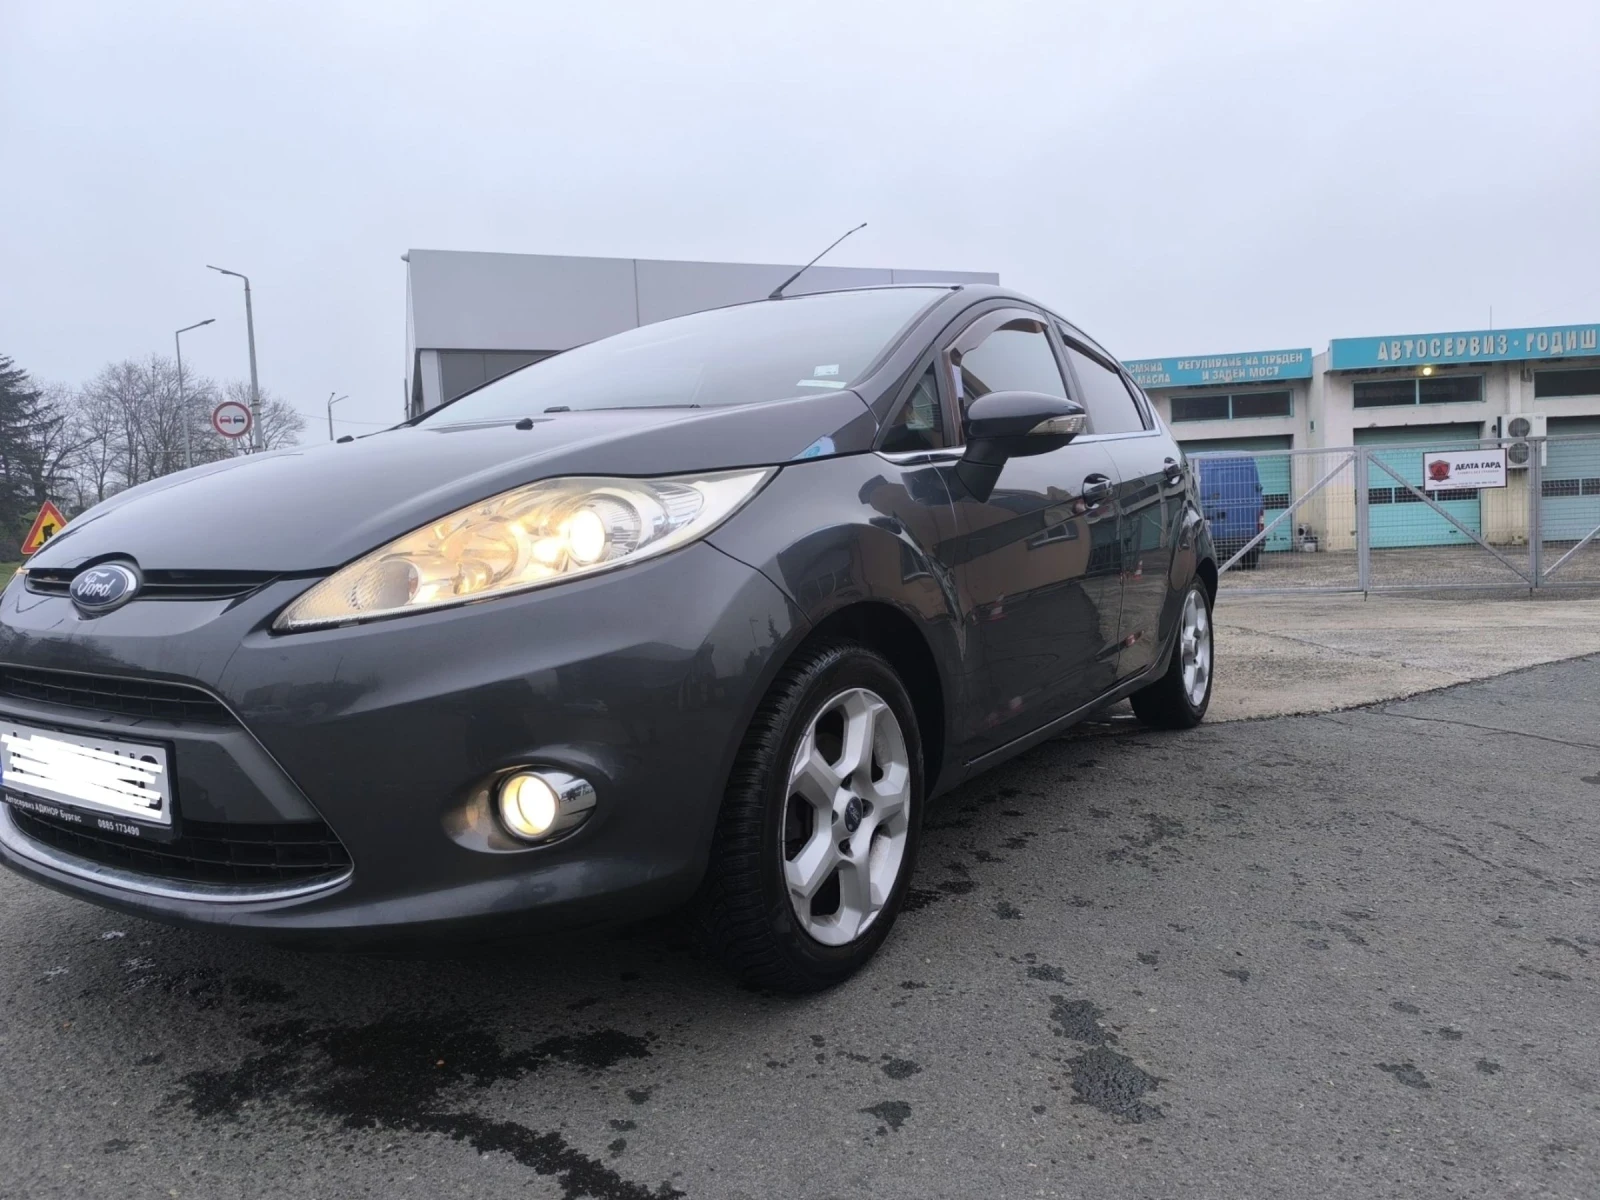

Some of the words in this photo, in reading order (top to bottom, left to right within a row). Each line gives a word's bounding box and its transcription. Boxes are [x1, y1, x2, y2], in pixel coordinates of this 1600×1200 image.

[1377, 334, 1508, 361] АВТОСЕРВИЗ
[1526, 329, 1597, 355] ГОДИШ
[1129, 362, 1163, 373] СМЯНА
[1177, 356, 1242, 370] РЕГУЛИРАНЕ
[1245, 356, 1258, 366] НА
[1262, 353, 1303, 365] ПРЕДЕН
[1137, 373, 1171, 385] МАСЛА
[1202, 371, 1209, 380] И
[1212, 369, 1245, 381] ЗАДЕН
[1250, 366, 1279, 377] МОСТ
[1455, 462, 1479, 471] ДЕЛТА
[1481, 461, 1502, 469] ГАРД
[77, 571, 116, 597] Ford
[60, 809, 82, 823] Бургас
